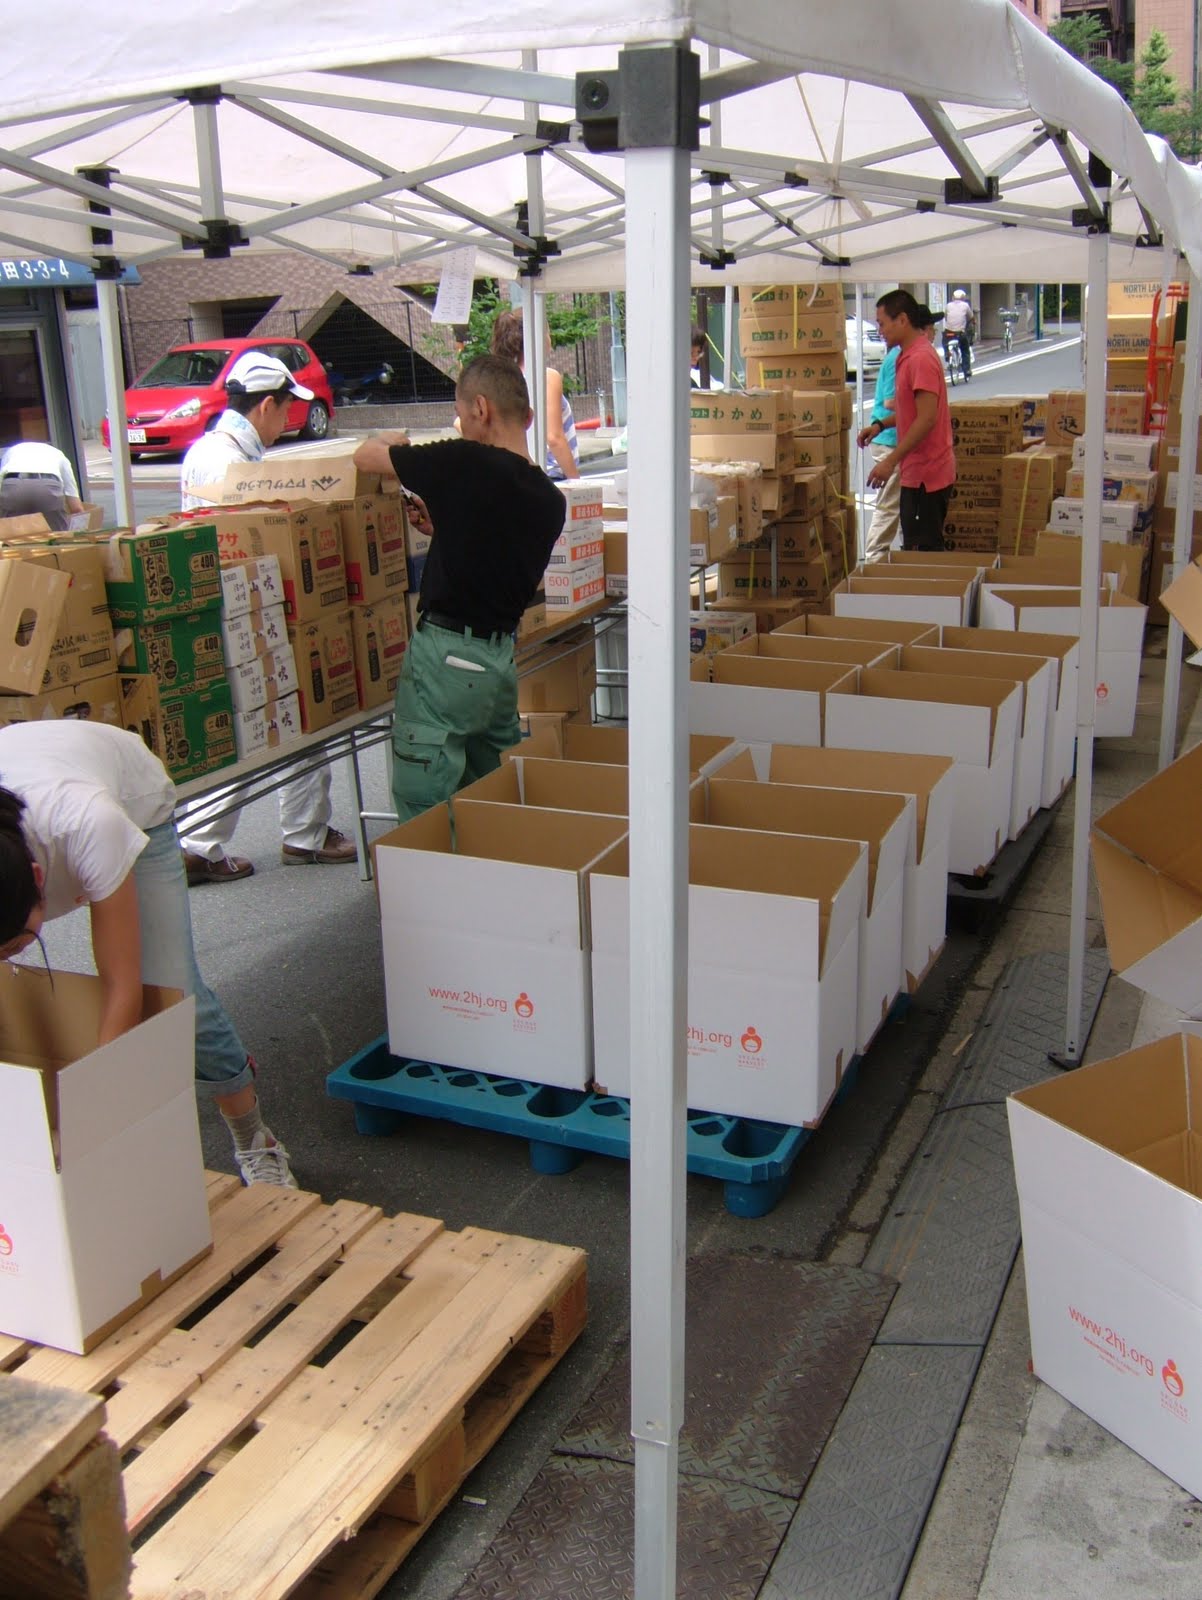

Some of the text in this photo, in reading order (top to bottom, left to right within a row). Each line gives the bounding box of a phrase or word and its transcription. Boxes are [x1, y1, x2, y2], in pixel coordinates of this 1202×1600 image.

[0, 259, 69, 279] 田3-3-4
[1123, 284, 1146, 294] NORTH
[1107, 338, 1131, 348] NORTH
[786, 366, 831, 379] わかめ
[712, 407, 762, 421] わかめ
[236, 478, 306, 491] ヤマサしょうゆ
[549, 576, 569, 586] 500
[428, 987, 508, 1013] www.2hj.org
[1068, 1305, 1154, 1377] www.2hj.org
